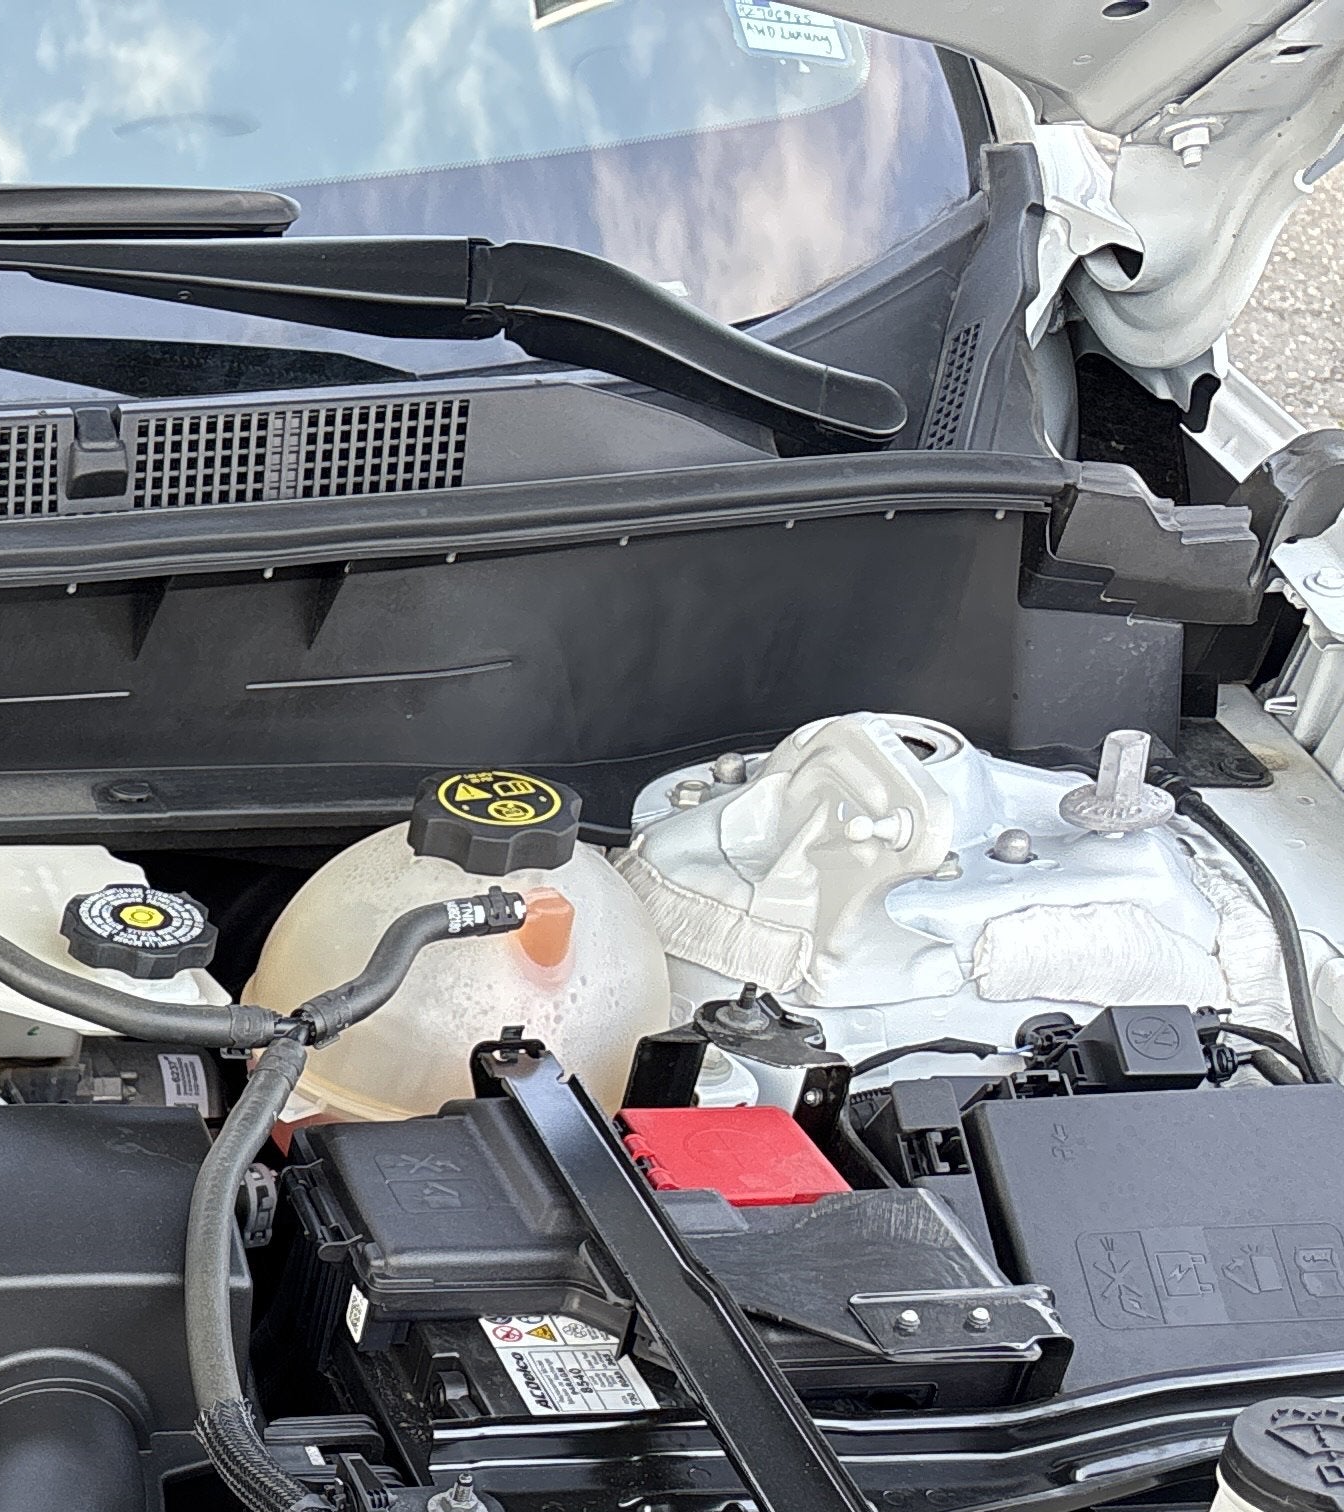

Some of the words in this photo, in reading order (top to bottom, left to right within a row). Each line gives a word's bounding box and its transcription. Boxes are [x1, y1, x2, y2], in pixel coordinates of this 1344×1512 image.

[746, 22, 776, 39] AWD
[780, 27, 833, 55] Luxury
[460, 901, 475, 928] TNK
[512, 1351, 553, 1410] ACDelco
